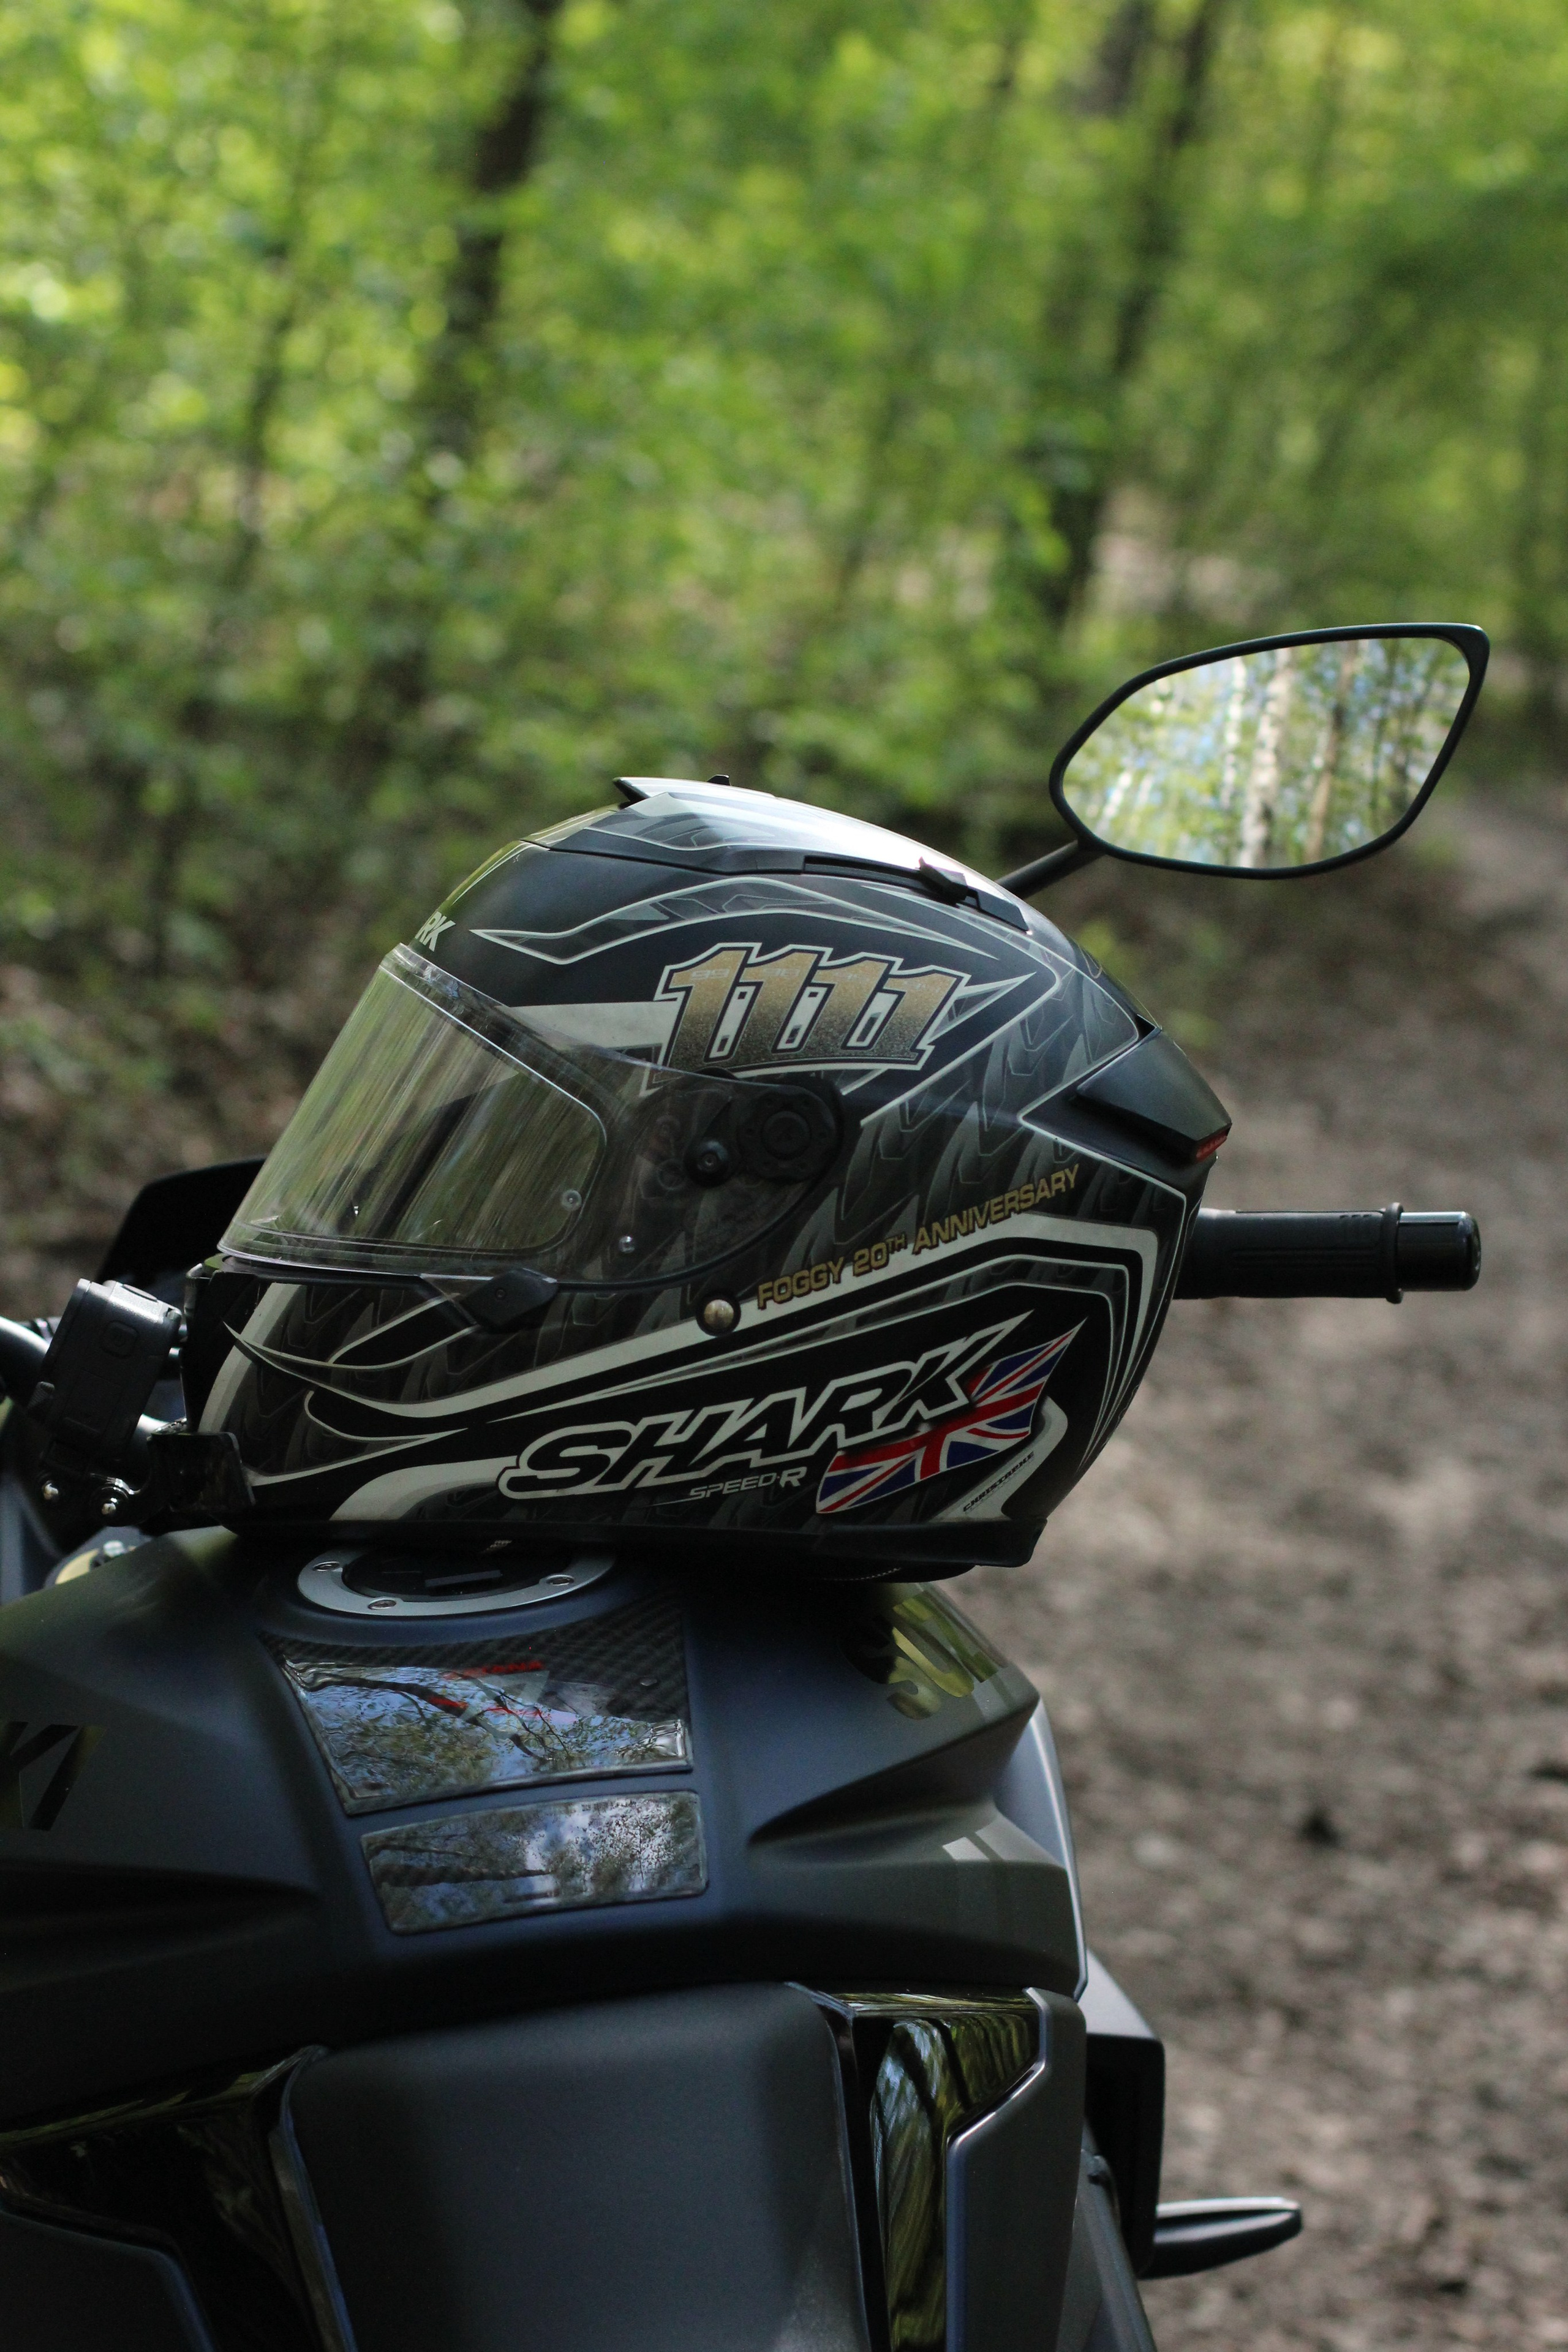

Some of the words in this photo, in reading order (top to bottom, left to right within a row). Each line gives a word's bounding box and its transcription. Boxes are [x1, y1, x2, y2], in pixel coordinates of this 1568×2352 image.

[653, 942, 971, 1083] 1111
[757, 1256, 845, 1310] FOGGY
[912, 1164, 1079, 1255] ANNIVERSARY
[498, 1310, 1034, 1499] SHARK
